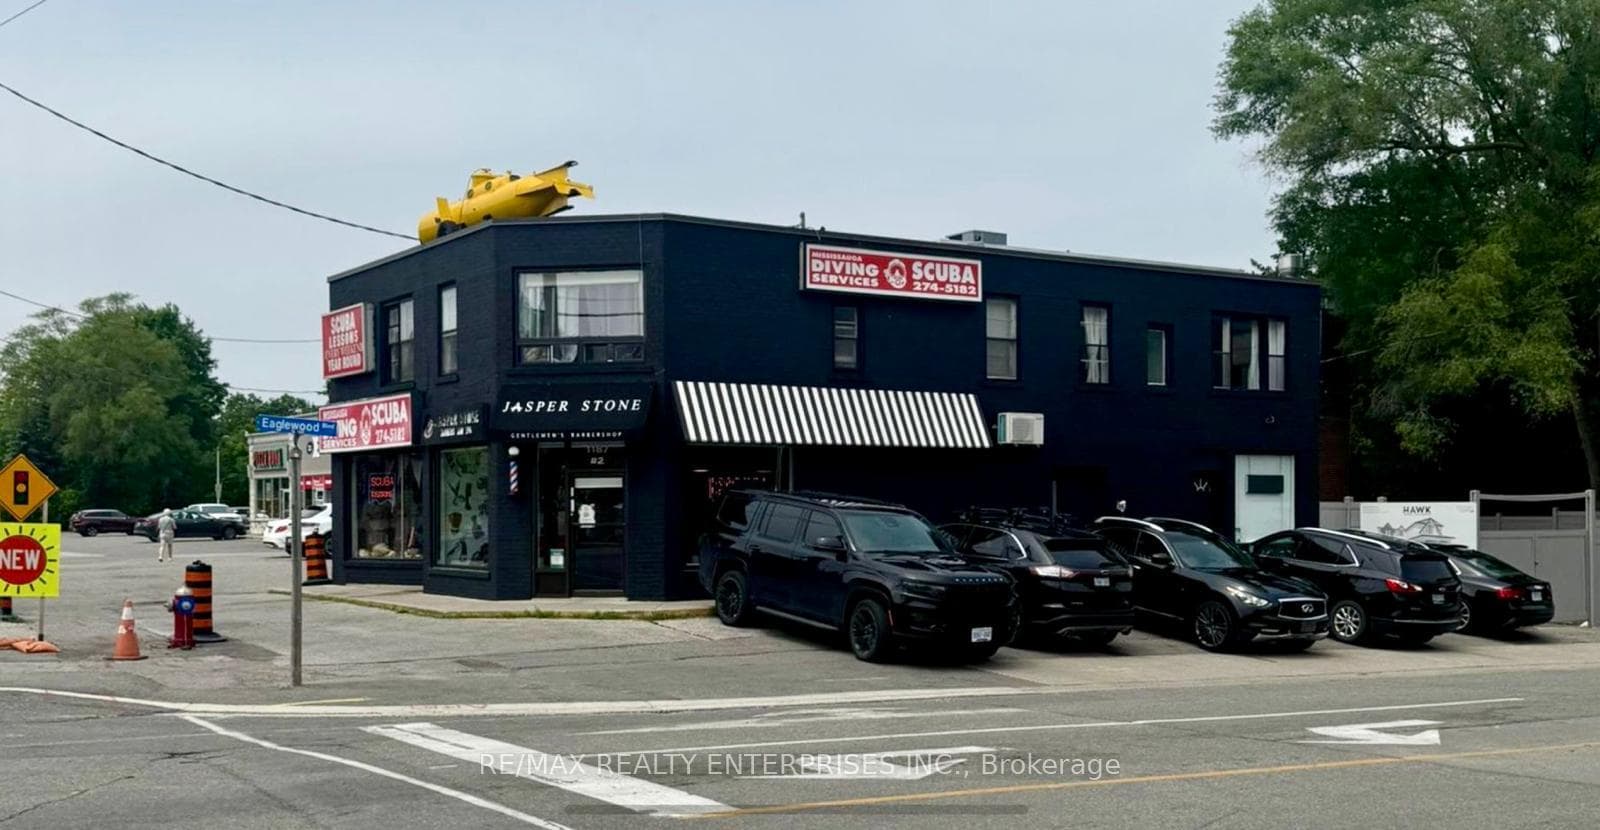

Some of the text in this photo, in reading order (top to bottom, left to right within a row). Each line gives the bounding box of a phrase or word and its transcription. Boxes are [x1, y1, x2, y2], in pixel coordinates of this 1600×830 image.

[811, 251, 863, 262] MISSISSAUGA
[811, 259, 879, 277] DIVING
[911, 261, 976, 284] SCUBA
[811, 273, 879, 287] SERVICES
[912, 281, 977, 295] 274-5182
[371, 400, 409, 426] SCUBA
[502, 399, 642, 413] JASPER STONE
[261, 417, 320, 432] Eaglewood
[590, 456, 605, 465] #2
[370, 475, 394, 486] SCUBA
[0, 549, 40, 570] NEW
